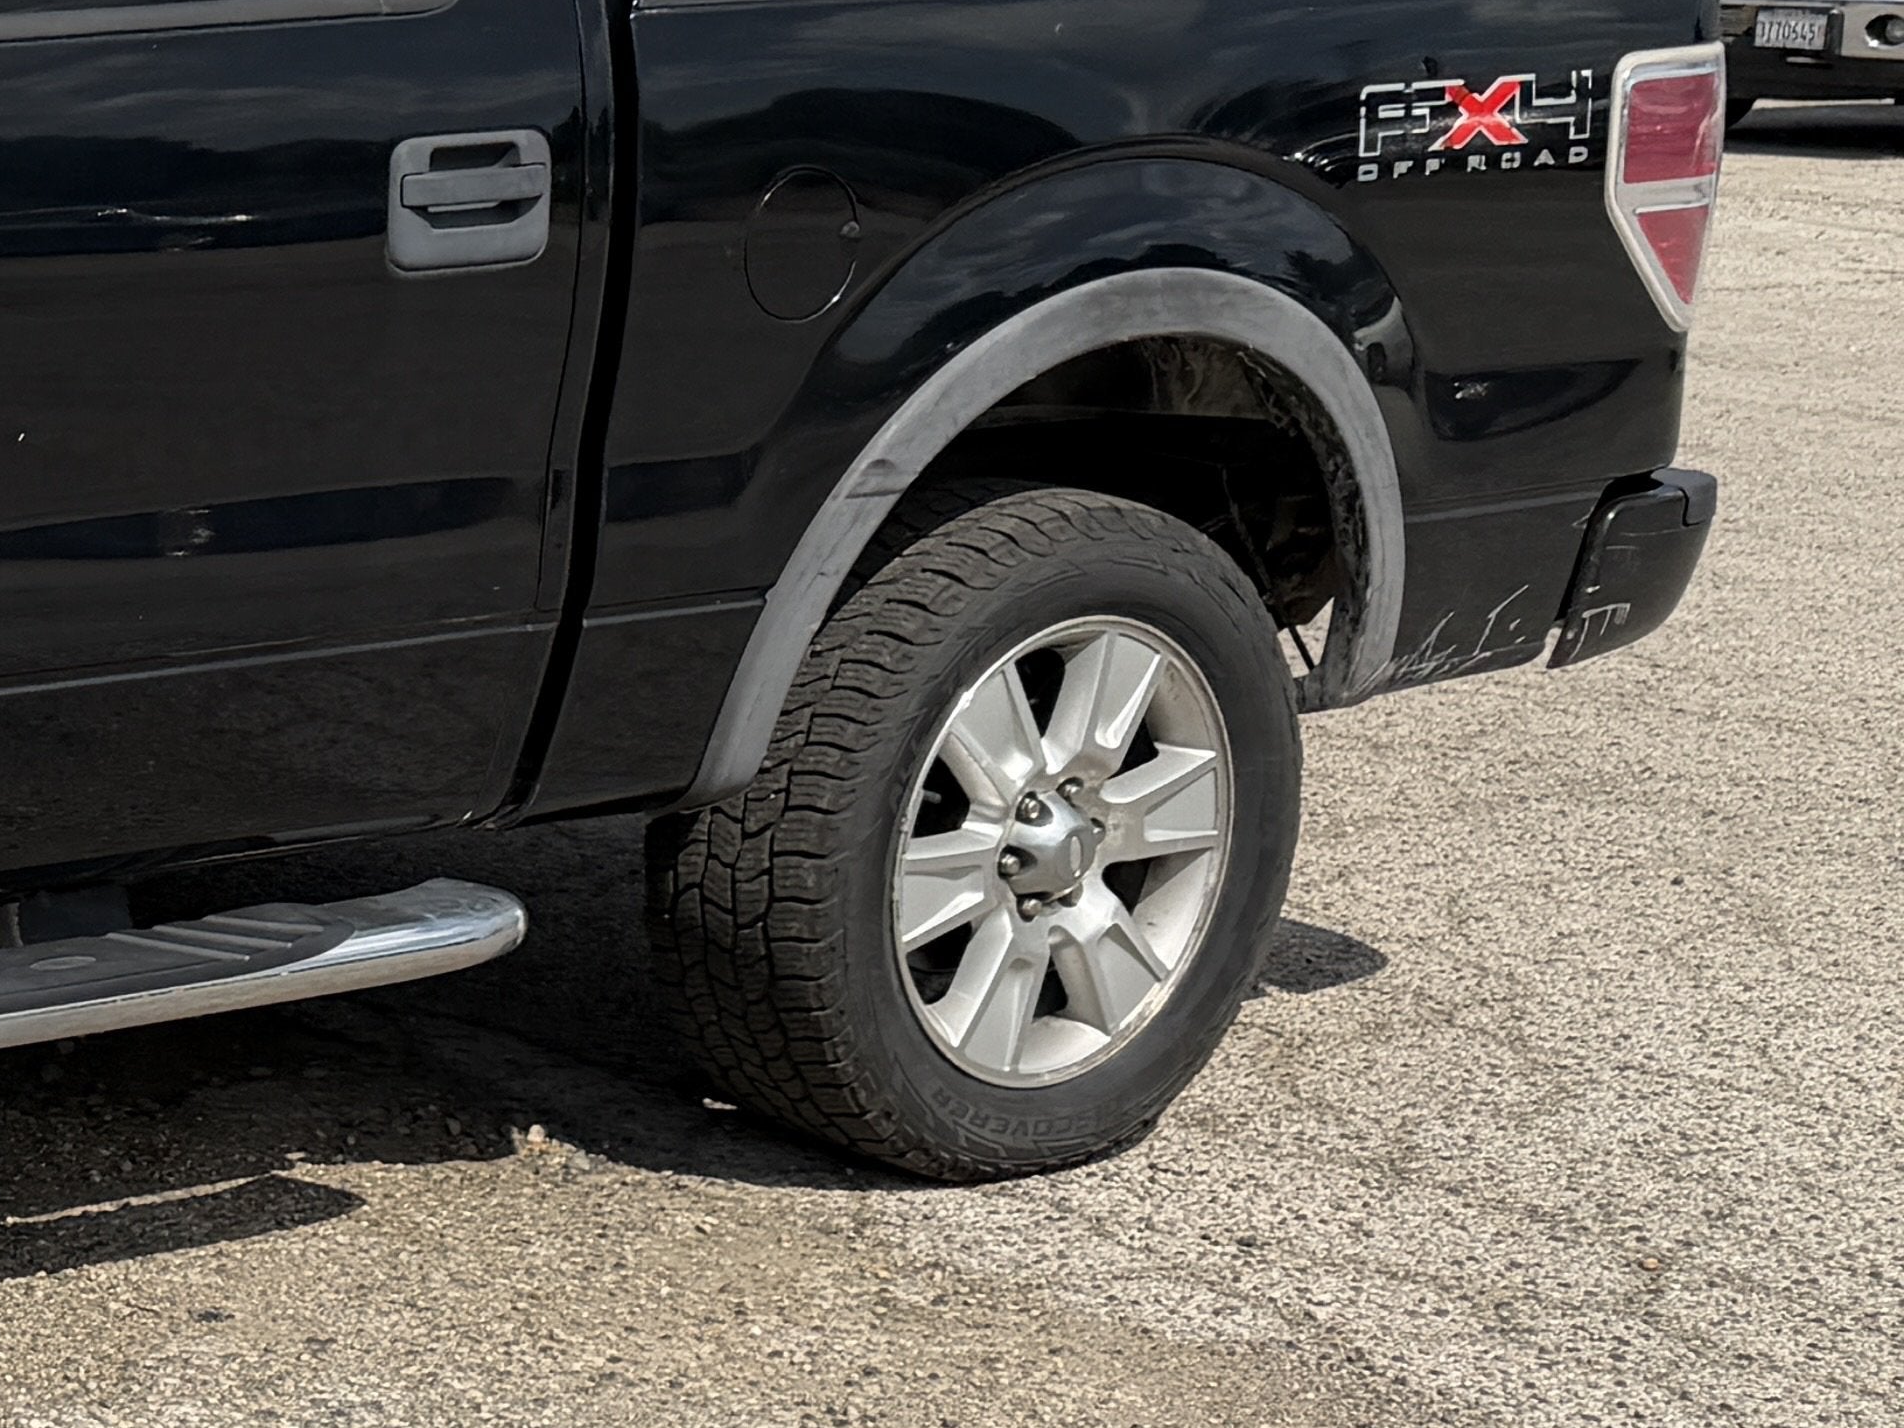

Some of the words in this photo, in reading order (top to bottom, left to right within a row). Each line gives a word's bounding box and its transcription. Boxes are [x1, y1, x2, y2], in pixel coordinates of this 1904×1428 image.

[1359, 69, 1592, 157] FX4
[1357, 158, 1445, 182] OFF
[1466, 146, 1589, 172] ROAD
